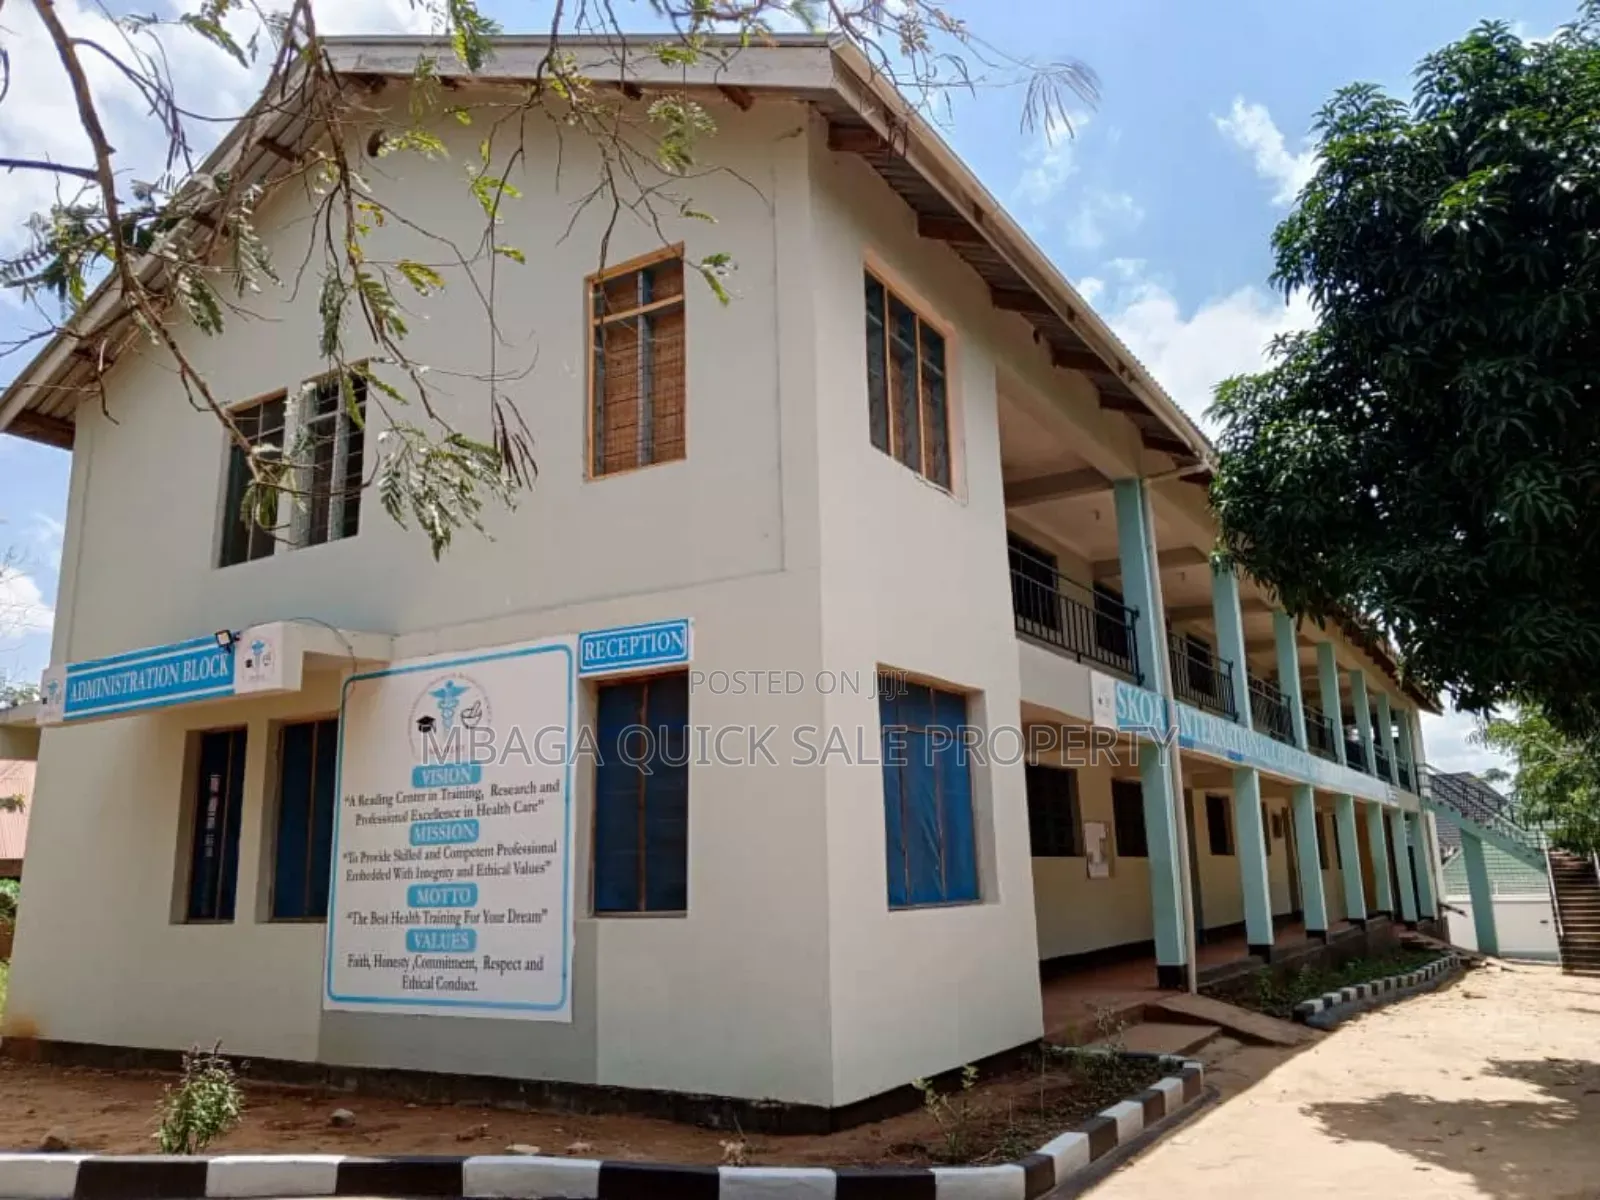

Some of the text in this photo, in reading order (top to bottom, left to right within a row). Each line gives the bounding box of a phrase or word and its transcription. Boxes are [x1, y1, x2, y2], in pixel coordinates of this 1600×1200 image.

[584, 628, 685, 661] RECEPTION
[69, 652, 230, 702] ADMINISTRATION BLOCK
[422, 766, 472, 785] VISION
[396, 790, 426, 804] Center
[428, 791, 437, 801] in
[441, 787, 484, 801] Training,
[490, 781, 536, 797] Research
[539, 779, 560, 793] and
[355, 811, 408, 826] Professional
[411, 807, 460, 820] Excellence
[463, 804, 473, 818] in
[476, 801, 511, 816] Health
[415, 822, 476, 842] MISSION
[360, 849, 391, 864] Provide
[393, 848, 422, 861] Skilled
[425, 847, 441, 859] and
[443, 845, 494, 861] Competent
[497, 839, 557, 856] Professional
[346, 868, 391, 882] Embedded
[393, 867, 414, 880] With
[416, 865, 454, 882] Integrity
[456, 864, 474, 877] and
[476, 862, 511, 876] Ethical
[416, 887, 471, 905] MOTTO
[370, 911, 388, 925] Best
[391, 911, 421, 925] Health
[423, 910, 461, 927] Training
[464, 909, 480, 924] For
[483, 908, 505, 924] Your
[413, 932, 469, 949] VALUES
[347, 953, 371, 970] Faith,
[374, 953, 410, 973] Honesty
[483, 954, 521, 976] Respect
[524, 955, 544, 971] and
[402, 974, 478, 992] Ethical Conduct.
